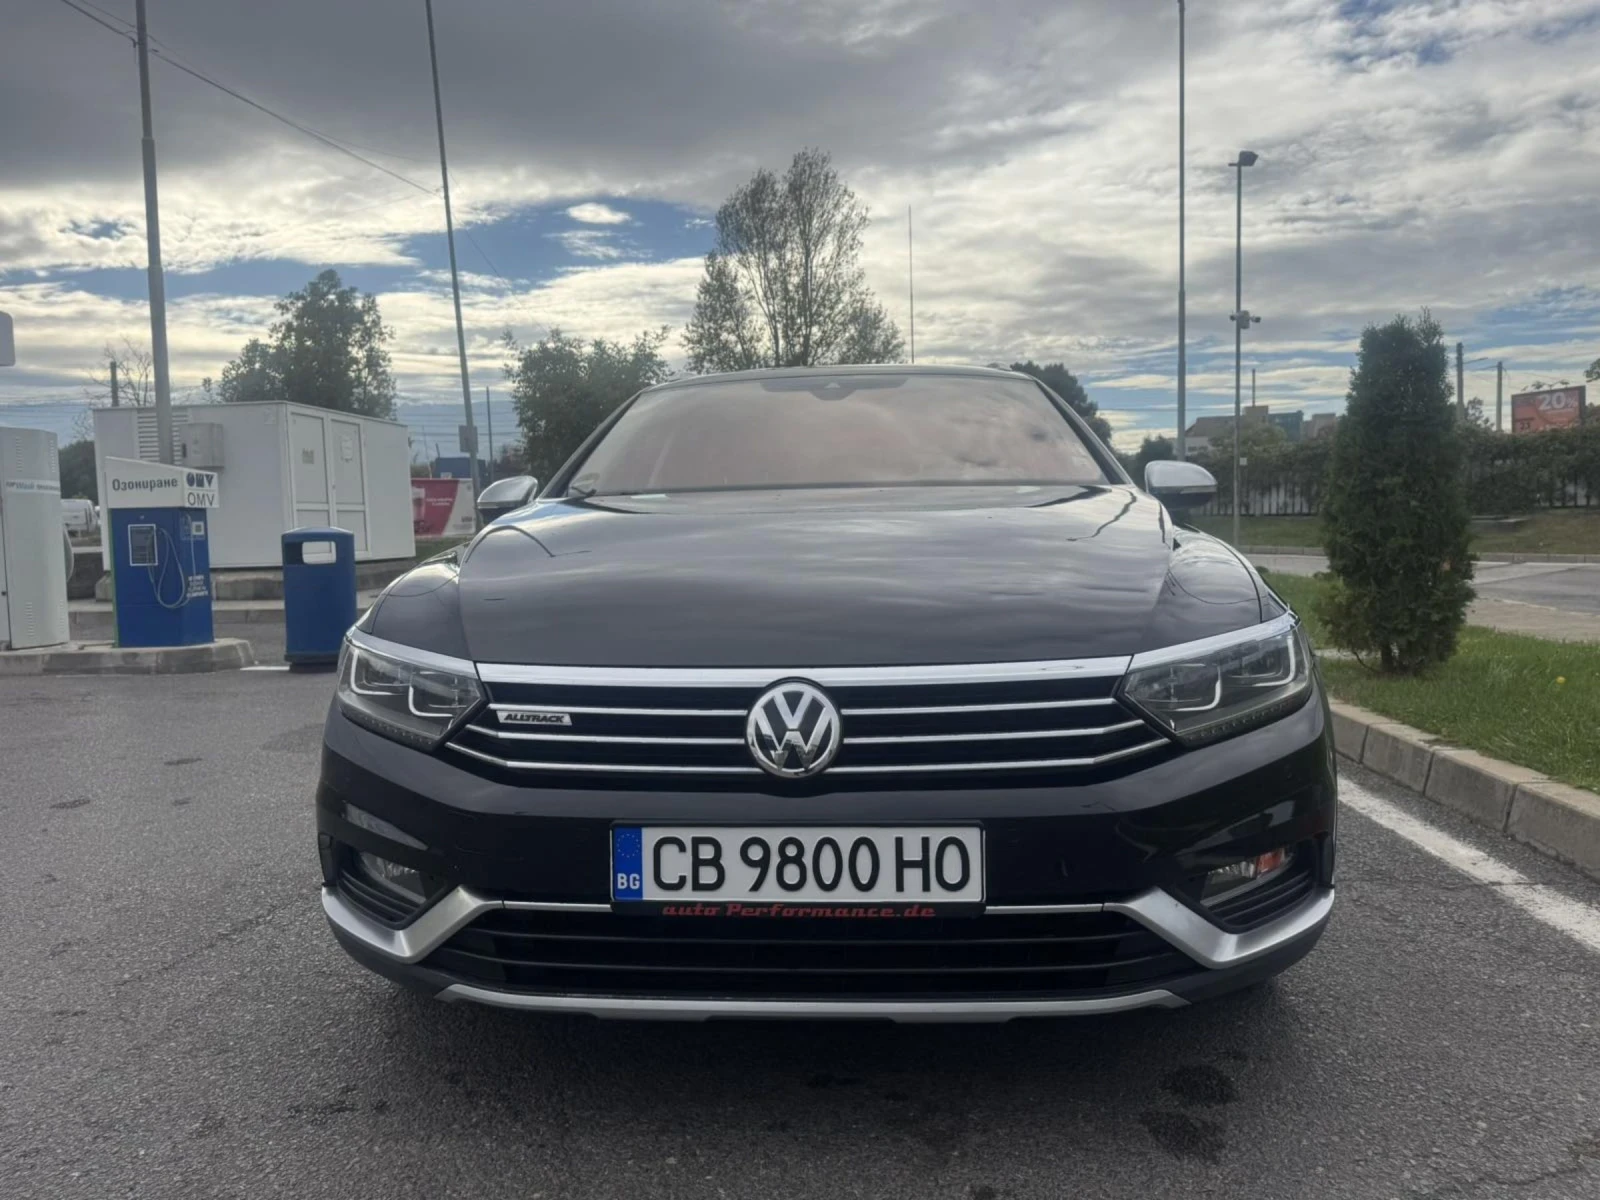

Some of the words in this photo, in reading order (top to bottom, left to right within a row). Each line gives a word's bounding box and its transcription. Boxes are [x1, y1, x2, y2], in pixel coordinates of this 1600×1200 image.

[112, 478, 178, 492] Озониране
[187, 492, 215, 506] OMV
[504, 713, 565, 722] ALLTRACK
[653, 836, 726, 892] CB
[739, 836, 880, 892] 9800
[895, 836, 970, 892] HO
[616, 873, 641, 890] BG
[662, 904, 719, 917] auto
[725, 903, 937, 918] Performance.de
